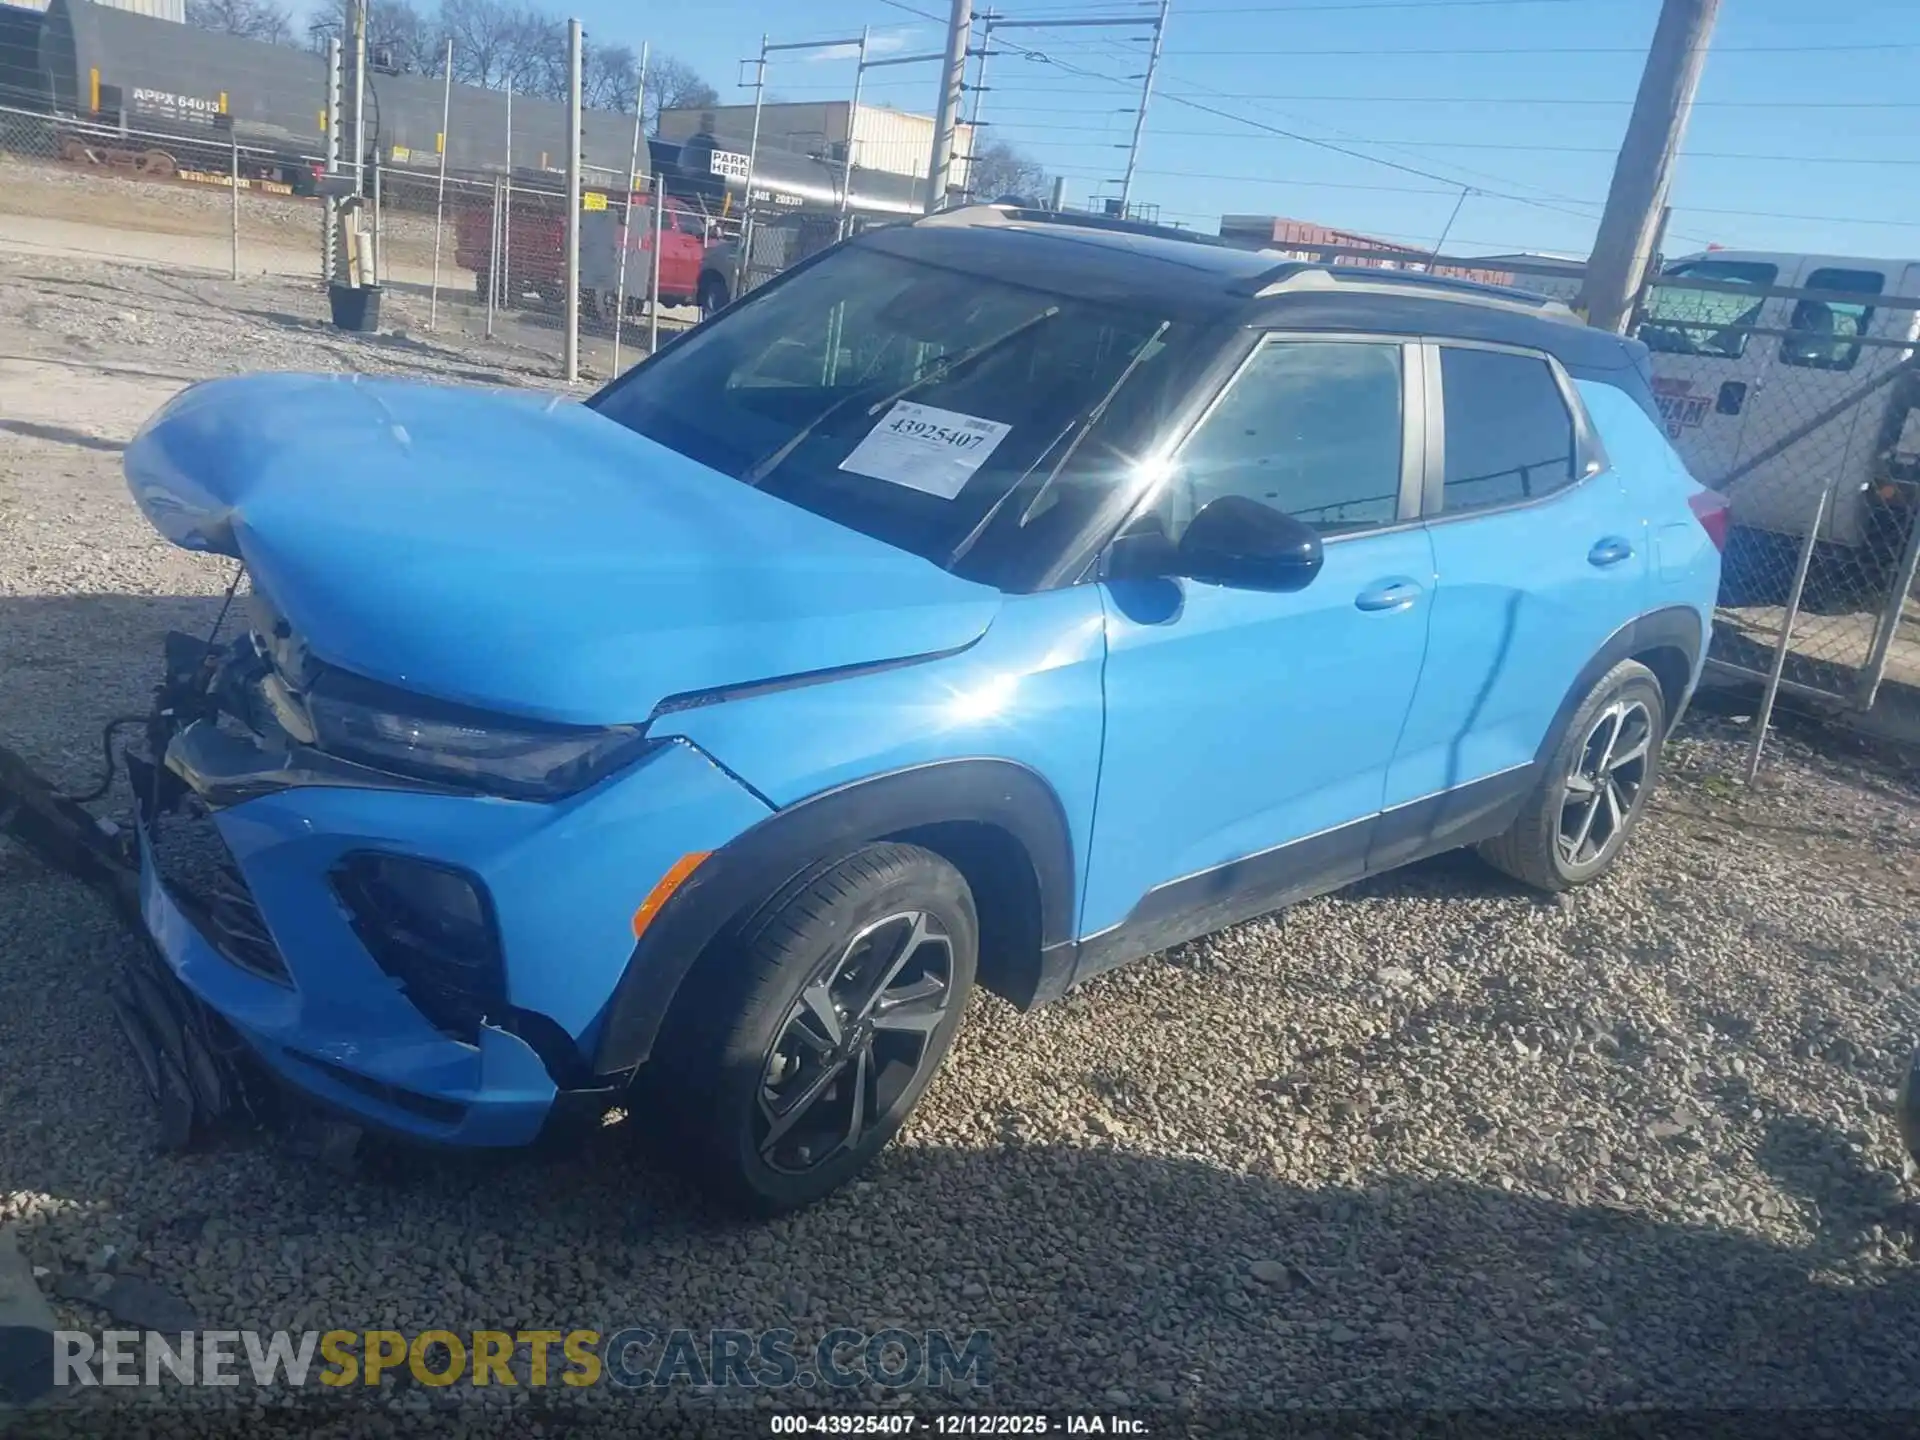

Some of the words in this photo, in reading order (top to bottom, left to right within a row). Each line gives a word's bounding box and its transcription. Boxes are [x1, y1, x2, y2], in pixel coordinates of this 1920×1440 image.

[133, 88, 176, 105] APPX
[713, 152, 749, 167] PARK
[712, 163, 748, 177] HERE
[890, 418, 984, 449] 43925407
